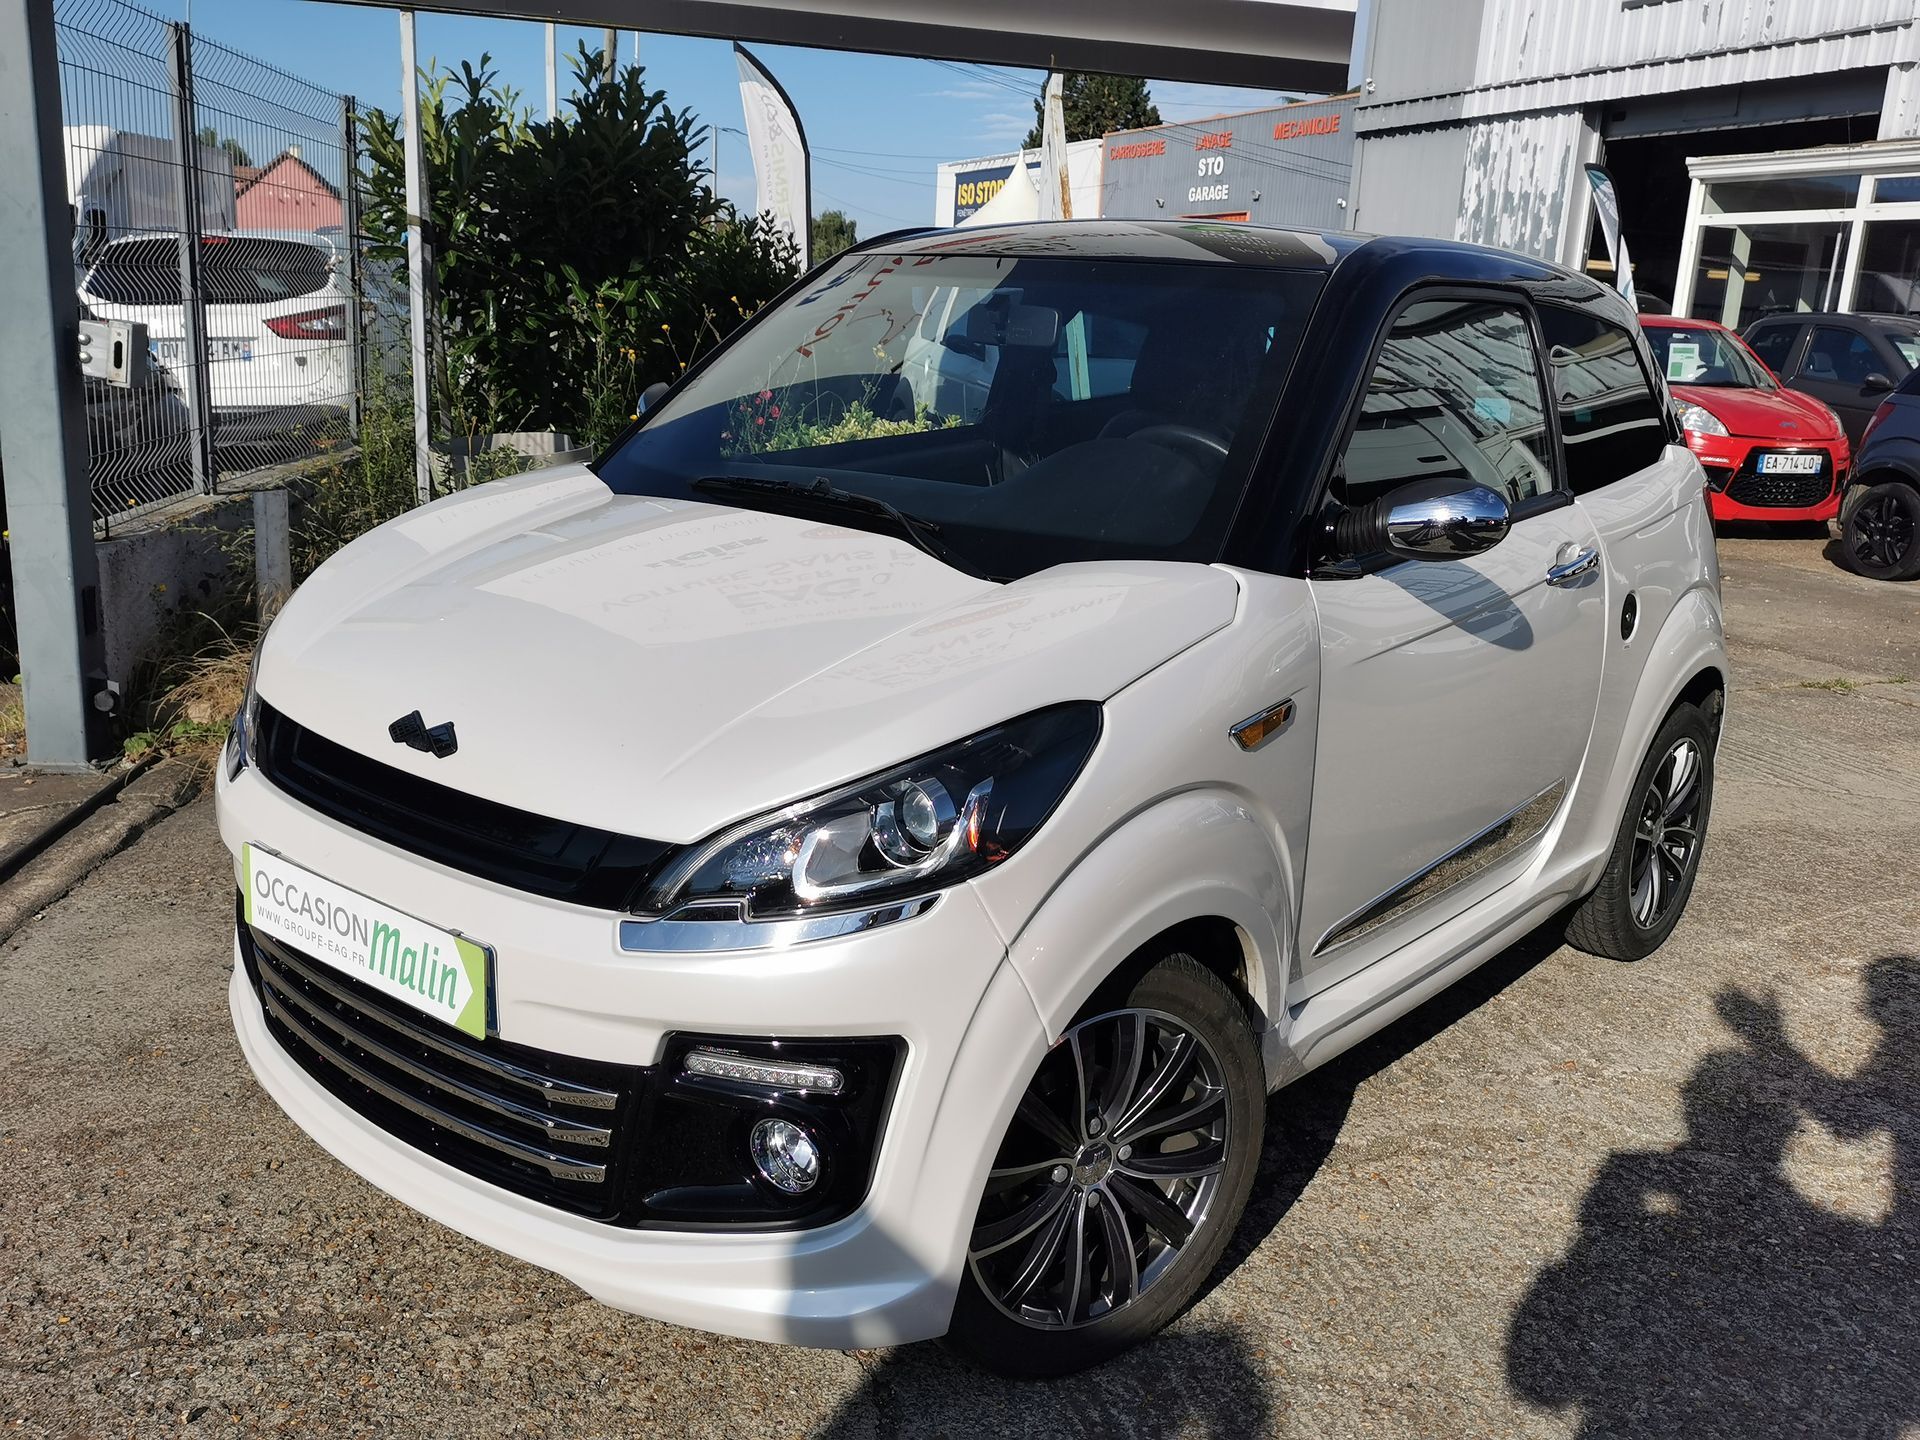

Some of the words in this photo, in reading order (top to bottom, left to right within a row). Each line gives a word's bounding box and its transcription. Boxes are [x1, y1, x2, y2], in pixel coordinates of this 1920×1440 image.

[1273, 114, 1341, 140] MECANIQUE
[1110, 140, 1166, 160] CARROSSERIE
[1195, 131, 1232, 151] LAVAGE
[1198, 156, 1224, 176] STO
[957, 183, 975, 206] ISO
[1189, 184, 1229, 202] GARAGE
[255, 870, 369, 947] OCCASION
